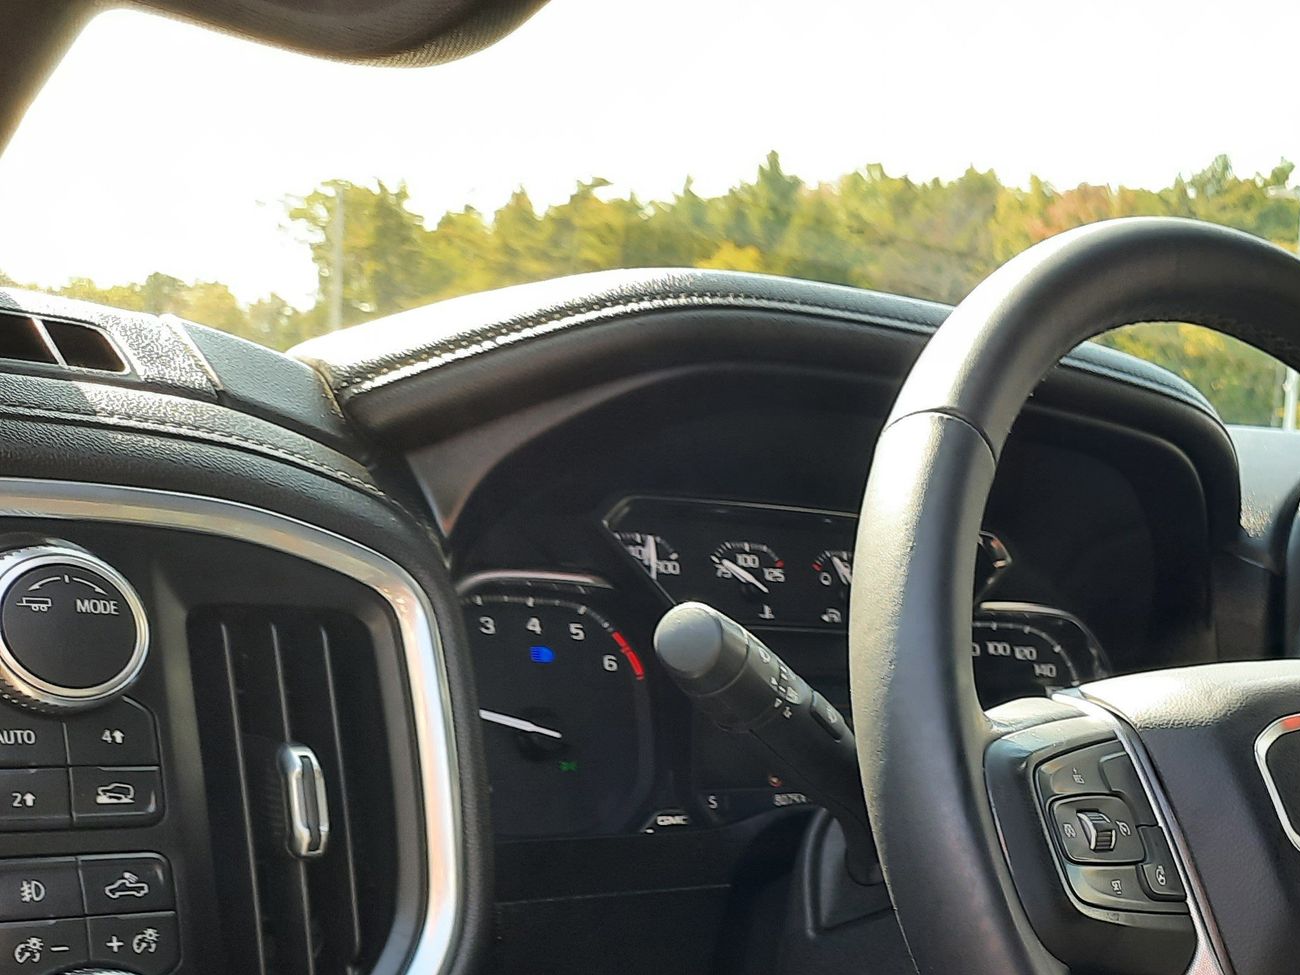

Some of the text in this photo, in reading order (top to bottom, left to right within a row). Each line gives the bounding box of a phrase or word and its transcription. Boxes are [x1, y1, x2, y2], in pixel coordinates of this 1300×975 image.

[736, 553, 759, 568] 100
[76, 599, 120, 615] MODE
[479, 616, 585, 640] 3 4 5
[986, 641, 1011, 656] 100
[1013, 646, 1037, 660] 120
[603, 655, 618, 672] 6
